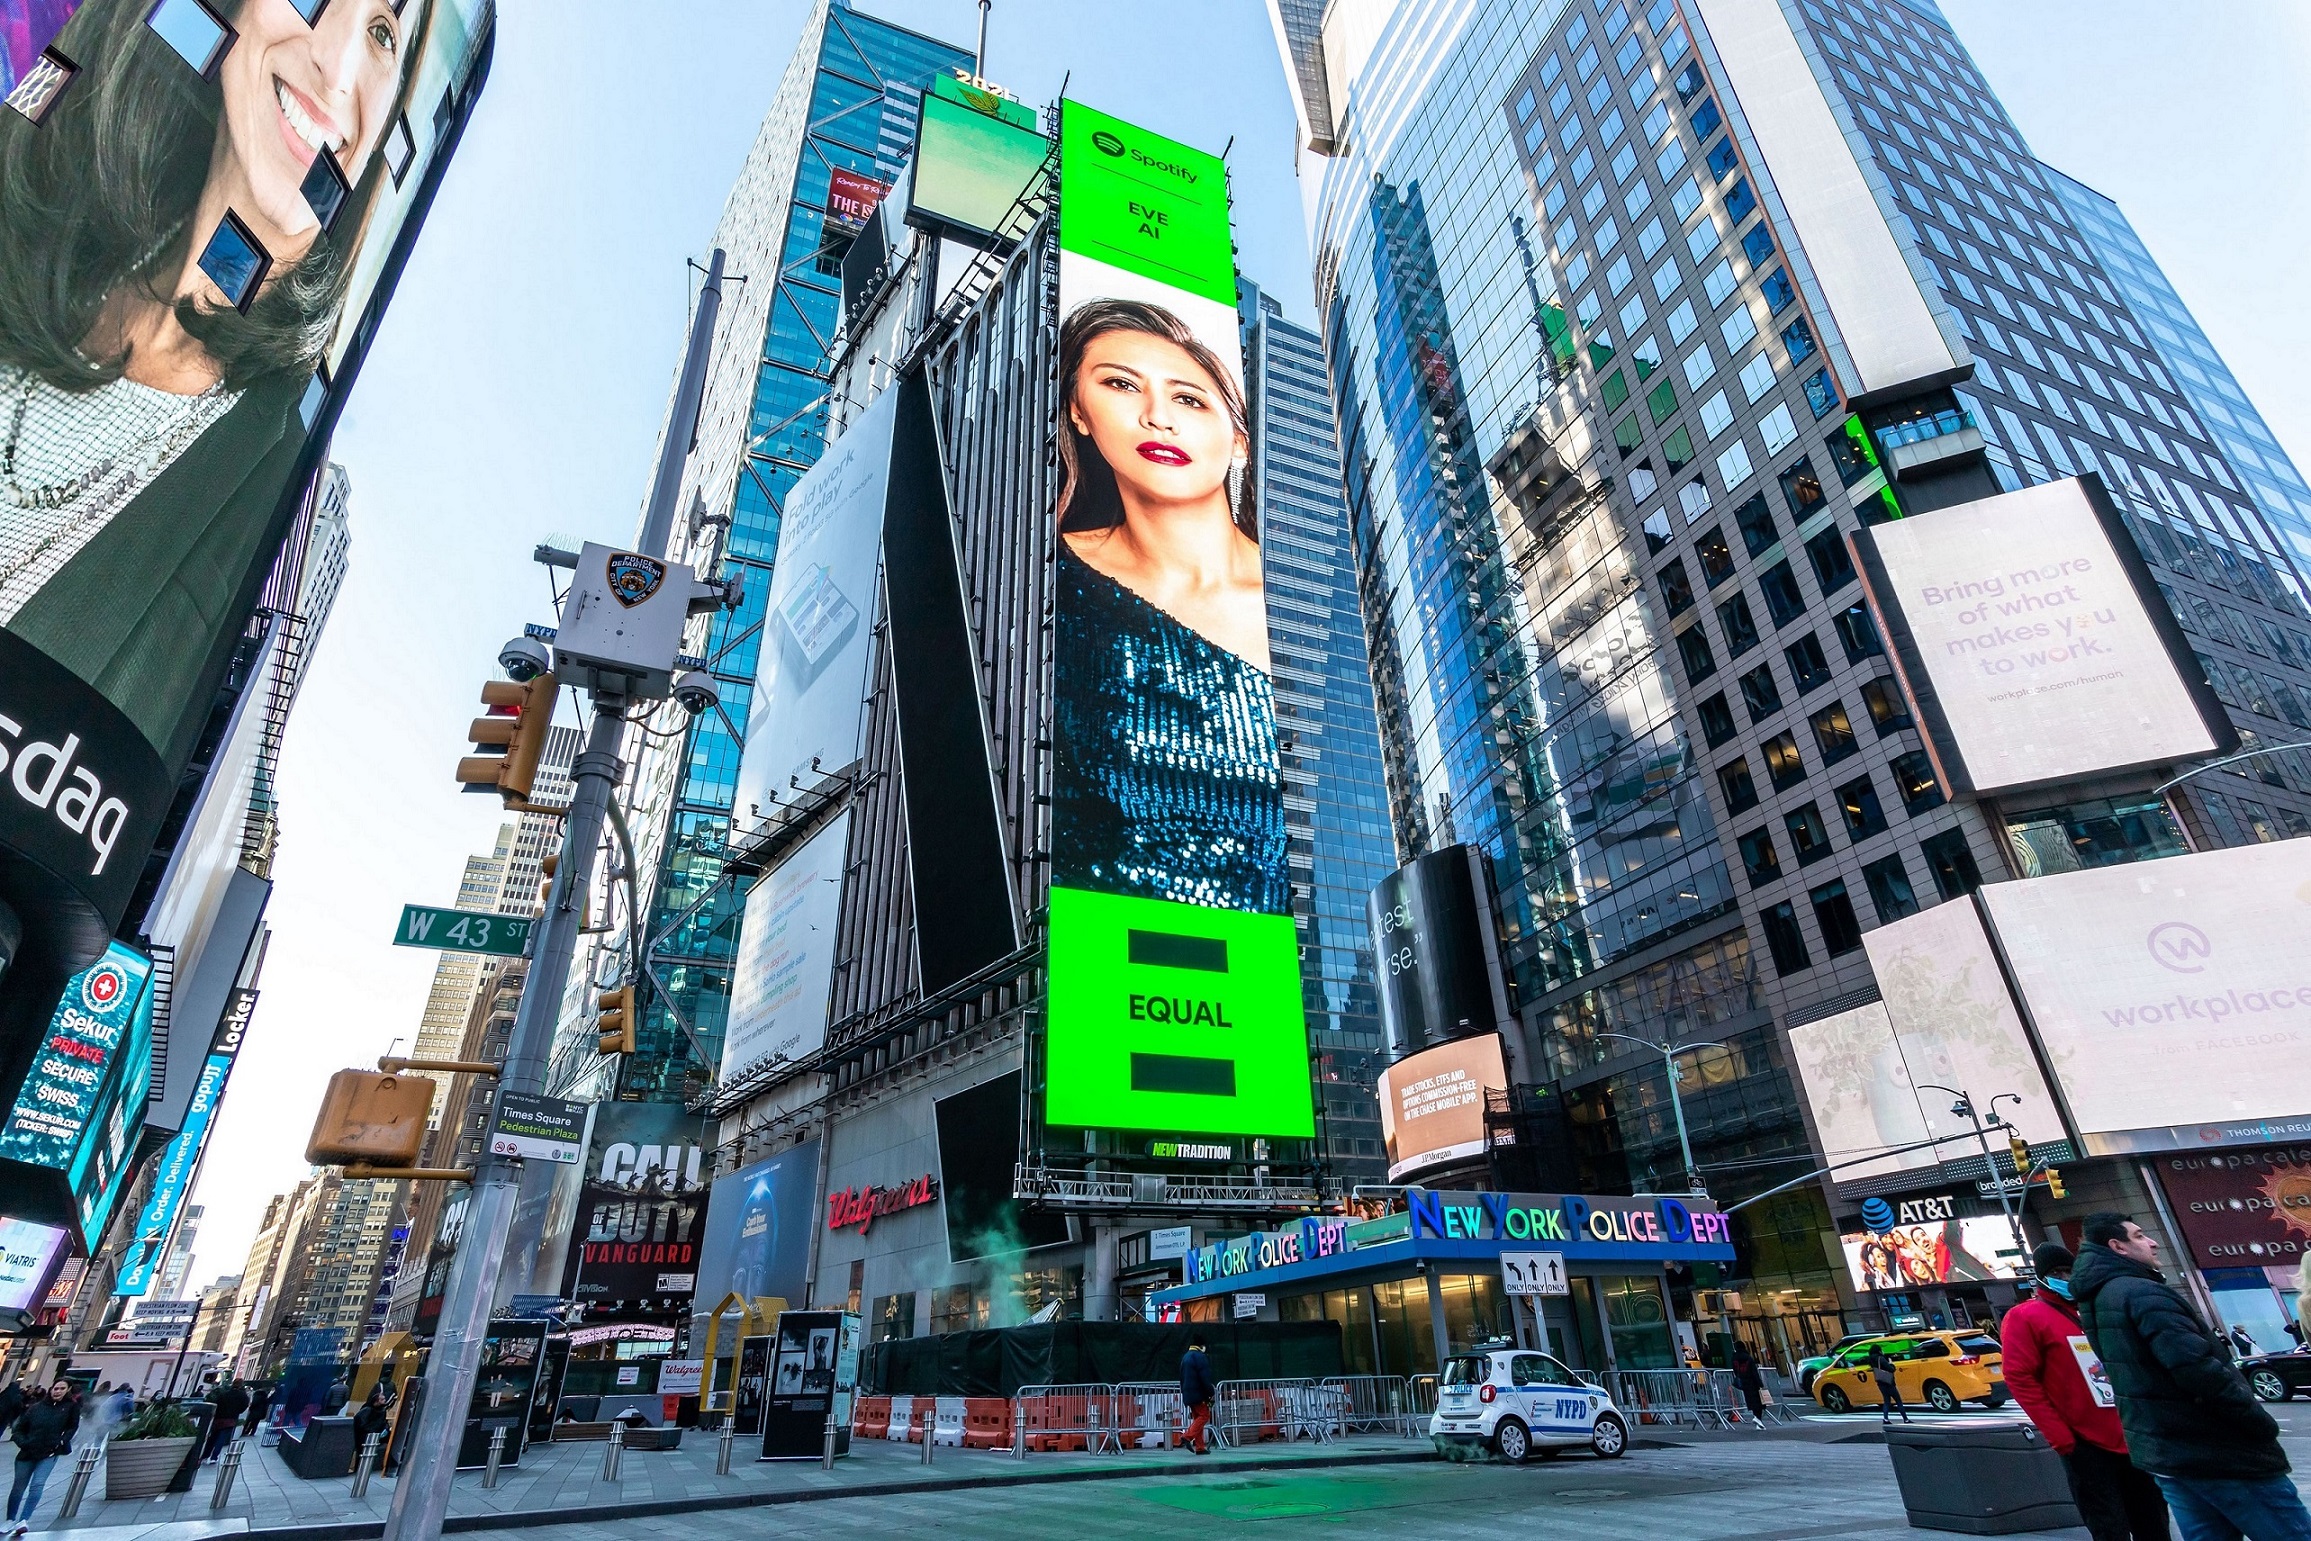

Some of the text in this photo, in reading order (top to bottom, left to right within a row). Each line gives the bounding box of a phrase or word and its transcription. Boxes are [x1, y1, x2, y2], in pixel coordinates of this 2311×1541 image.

[954, 68, 1010, 101] 2021
[1131, 148, 1198, 184] Spotify
[833, 194, 860, 215] THE
[1128, 201, 1169, 226] EVE
[1138, 223, 1160, 240] AI
[788, 448, 855, 526] Fold work
[849, 472, 874, 498] Google
[784, 479, 843, 548] into play
[611, 560, 661, 577] DEPARTMENT
[624, 556, 654, 566] POLICE
[1921, 558, 2092, 606] Bring more
[633, 592, 646, 602] NEW
[1958, 585, 2080, 625] of what
[526, 623, 558, 638] NYPD
[1946, 622, 2050, 656] makes
[678, 656, 706, 667] NYPD
[1980, 636, 2113, 676] to work.
[1987, 670, 2124, 702] workplace.com/human
[408, 911, 527, 947] W 43 ST
[1129, 994, 1232, 1028] EQUAL
[2101, 987, 2311, 1028] workplace
[60, 1008, 116, 1041] Sekur
[217, 993, 256, 1052] Locker.
[51, 1036, 104, 1064] PRIVATE
[780, 1033, 801, 1052] Google
[2195, 1031, 2301, 1050] FACEBOOK
[41, 1059, 96, 1085] SECURE
[1416, 1078, 1436, 1095] STOCKS,
[1436, 1073, 1450, 1086] ETFS
[1451, 1069, 1465, 1083] AND
[37, 1086, 79, 1107] SWISS
[191, 1064, 222, 1113] gopuff
[1422, 1080, 1477, 1103] COMMISSION-FREE
[503, 1106, 571, 1126] Times Square
[1420, 1102, 1436, 1117] CHASE
[1462, 1092, 1478, 1104] APP.
[500, 1120, 578, 1140] Pedestrian Plaza
[2227, 1123, 2285, 1137] THOMSON
[151, 1131, 195, 1222] Order. Delivered.
[601, 1142, 705, 1192] CALL
[1408, 1190, 1730, 1243] NEW YORK POLICE DEPT
[1900, 1196, 1955, 1224] AT&T
[2190, 1195, 2276, 1213] europa
[588, 1201, 699, 1243] DUTY
[592, 1213, 605, 1225] OF
[1171, 1230, 1186, 1238] Square
[1251, 1231, 1299, 1271] POLICE
[1302, 1217, 1347, 1260] DEPT
[5, 1253, 37, 1268] VIATRIS
[585, 1244, 693, 1263] VANGUARD
[2209, 1241, 2298, 1258] europa
[1507, 1284, 1525, 1292] ONLY
[1527, 1284, 1544, 1292] ONLY
[1548, 1284, 1565, 1292] ONLY
[1453, 1385, 1473, 1393] POLICE
[1555, 1399, 1587, 1419] NYPD
